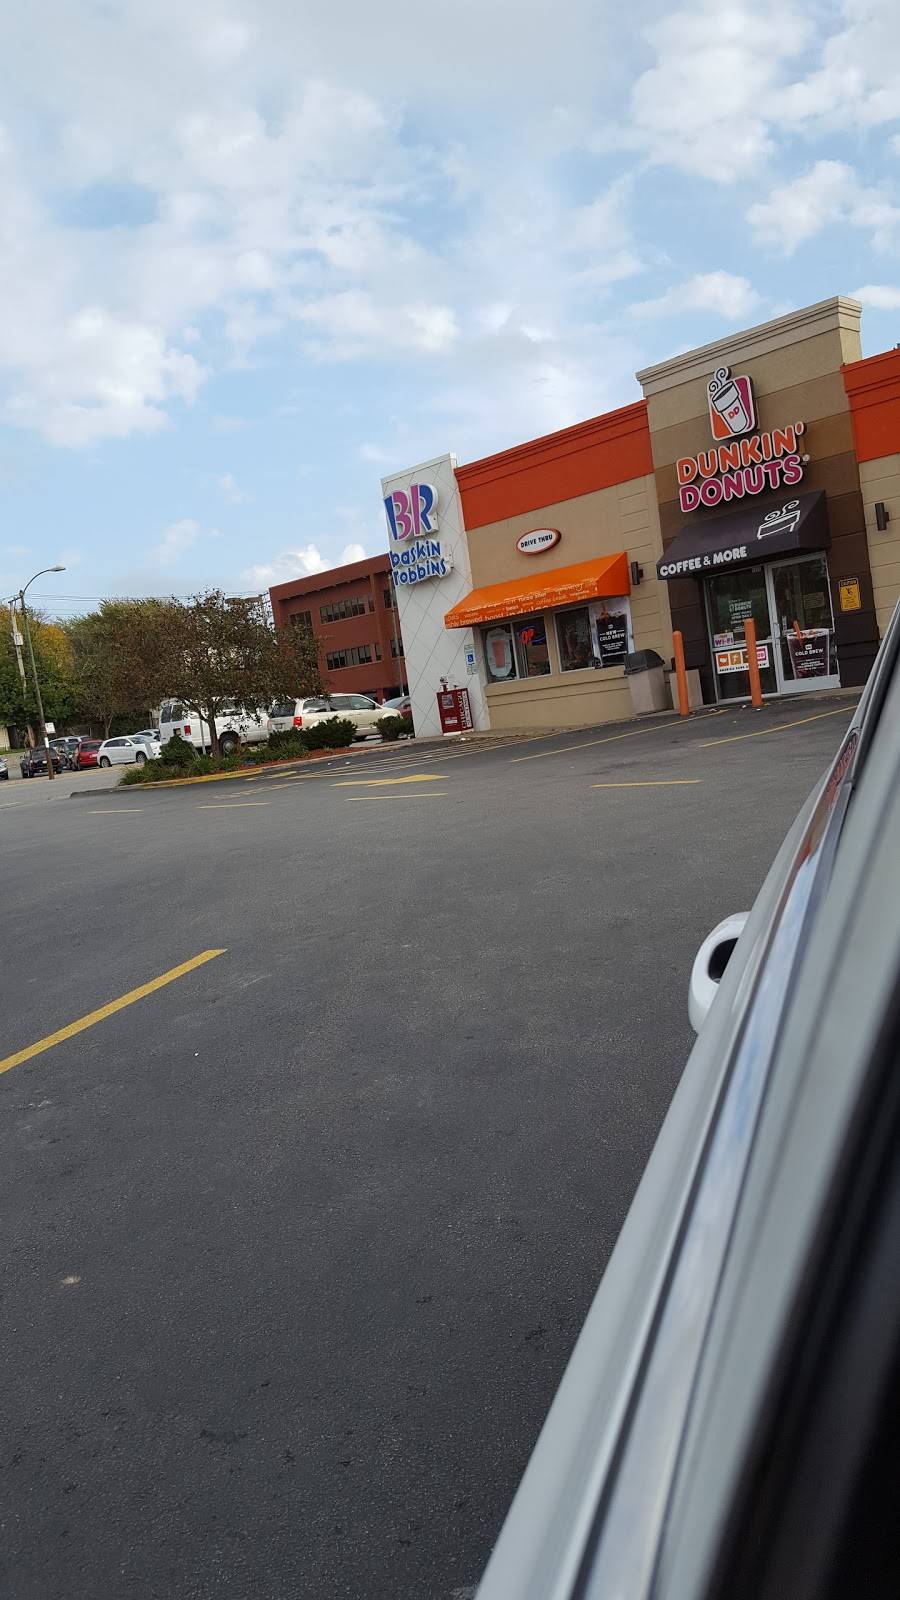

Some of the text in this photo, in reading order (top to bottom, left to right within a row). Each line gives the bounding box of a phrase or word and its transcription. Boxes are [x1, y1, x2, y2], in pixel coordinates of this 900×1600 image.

[728, 406, 740, 419] DD
[677, 421, 804, 485] DUNKIN'
[680, 455, 802, 512] DONUTS
[384, 484, 435, 540] BR
[389, 541, 441, 567] baskin
[521, 534, 553, 548] DRIVE THRU
[392, 558, 447, 585] robbins
[660, 546, 747, 576] COFFEE & MORE
[612, 632, 626, 640] BREW
